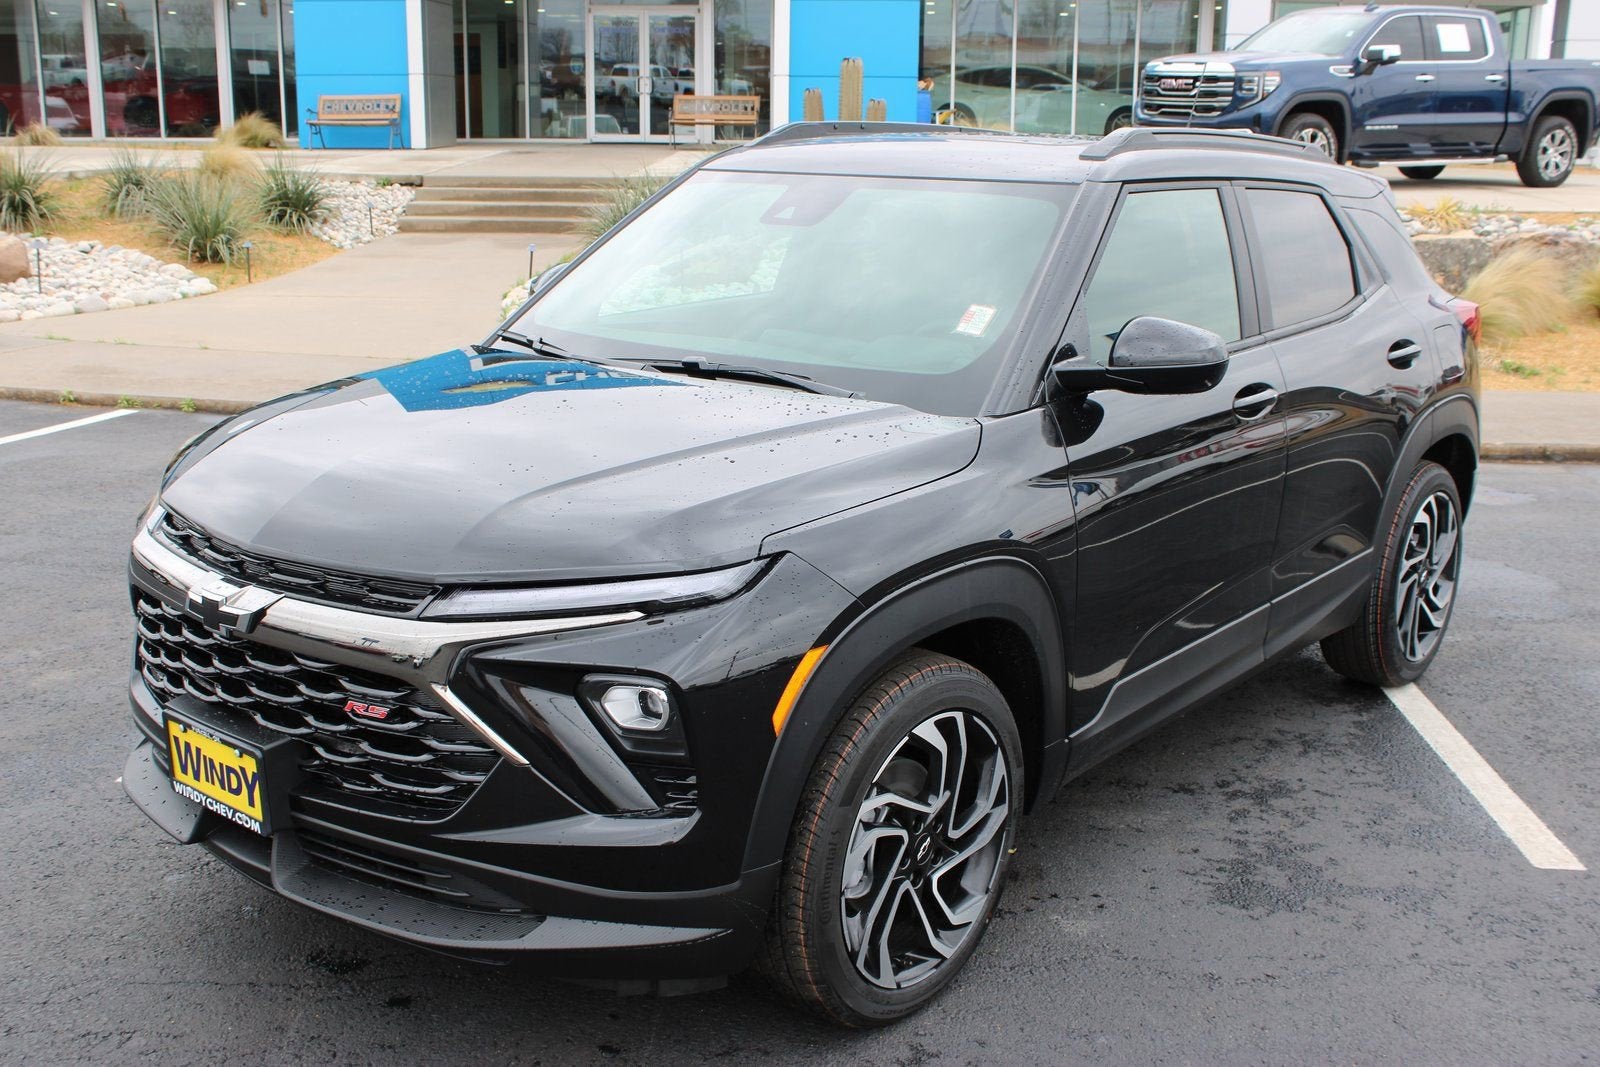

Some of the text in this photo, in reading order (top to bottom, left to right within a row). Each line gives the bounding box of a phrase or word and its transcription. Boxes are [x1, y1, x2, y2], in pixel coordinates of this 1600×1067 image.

[1160, 78, 1194, 90] GMC
[344, 700, 390, 719] RS
[173, 735, 260, 809] WINDY
[173, 781, 262, 834] WINDYCHEV.COM
